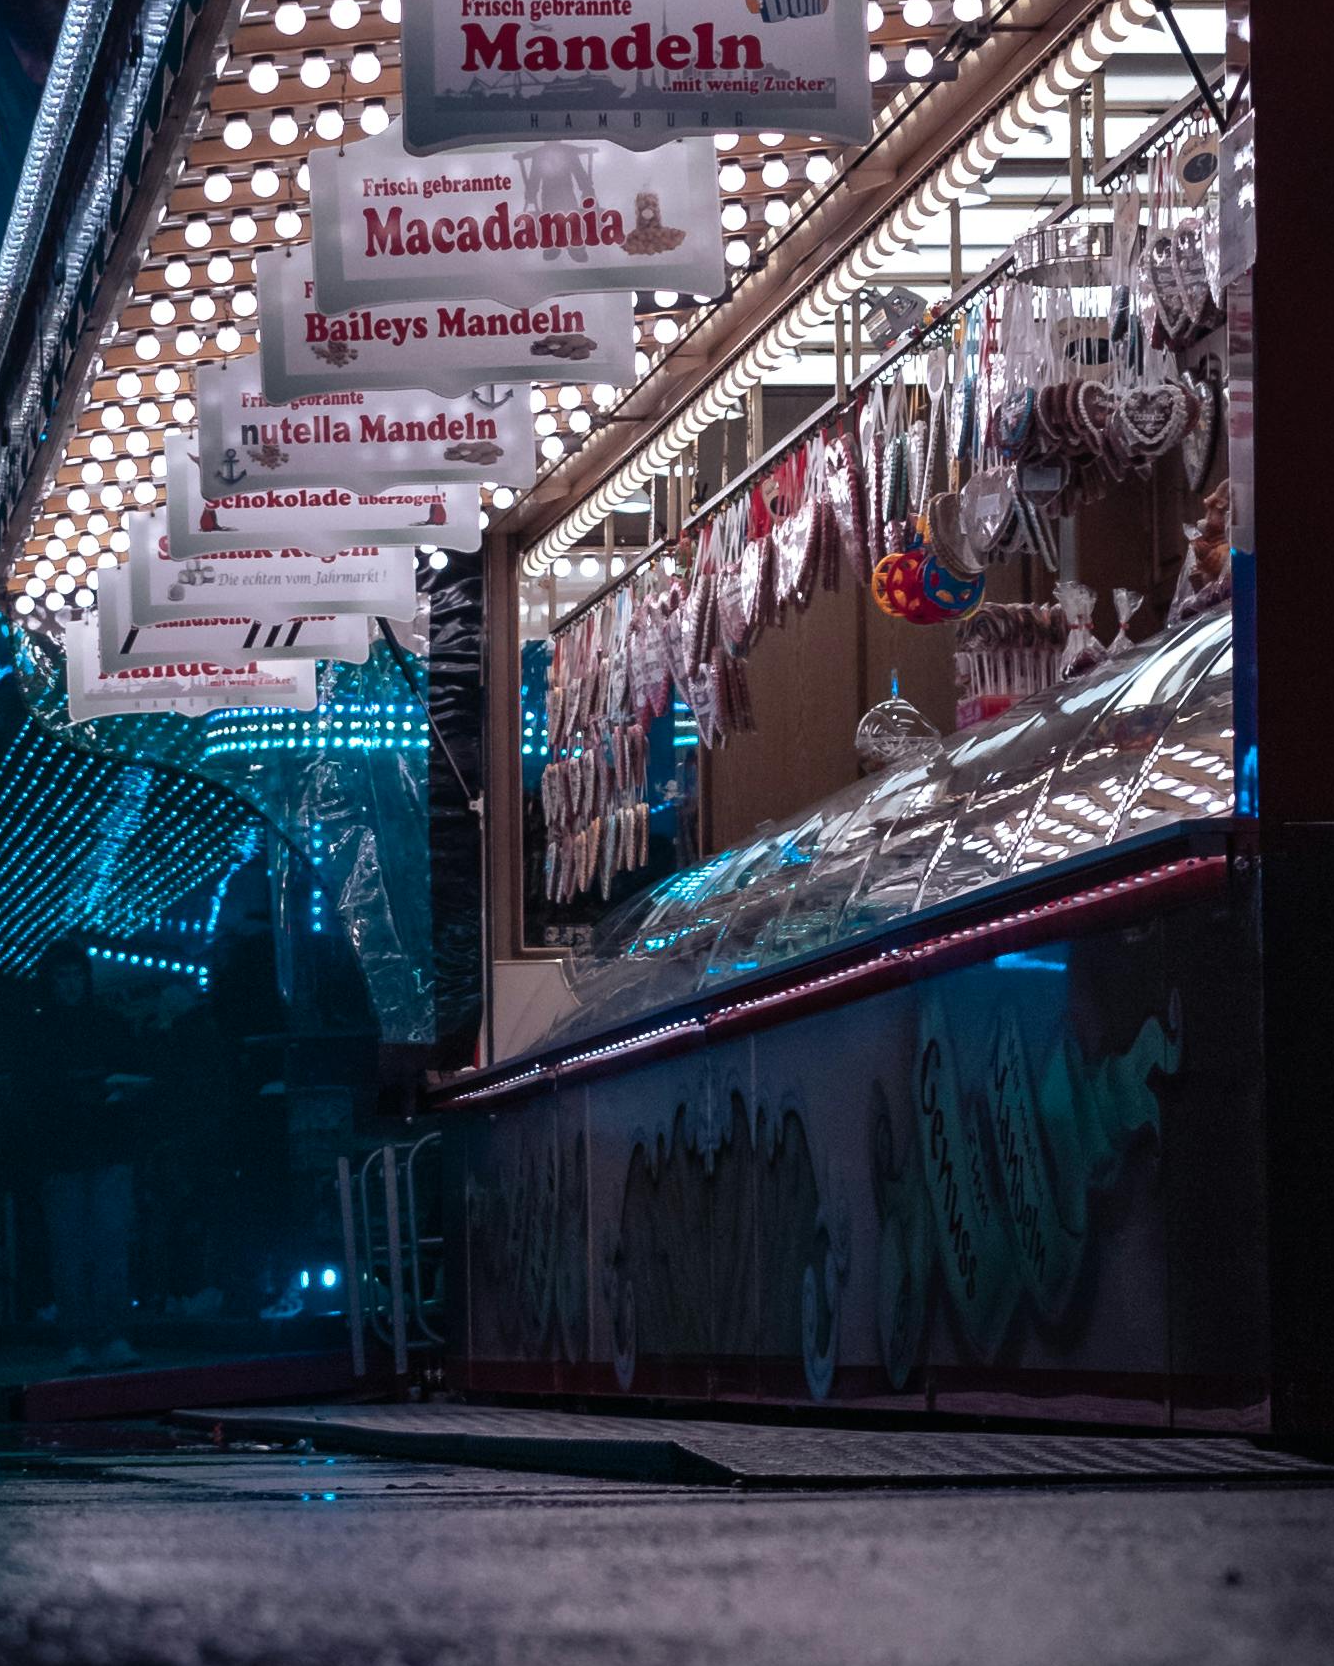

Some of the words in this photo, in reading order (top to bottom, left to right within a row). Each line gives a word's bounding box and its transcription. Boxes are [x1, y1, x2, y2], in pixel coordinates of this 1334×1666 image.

[460, 21, 765, 73] Mandeln
[705, 76, 760, 95] wenig
[763, 76, 827, 93] Zucker
[530, 110, 745, 130] HAMBURG
[362, 176, 418, 197] Frisch
[422, 173, 512, 199] gebrannte
[362, 197, 627, 258] Macadamia
[304, 310, 429, 345] Baileys
[436, 304, 586, 338] Mandeln
[241, 414, 352, 446] nutella
[359, 412, 497, 444] Mandeln
[217, 572, 240, 587] Die
[242, 572, 283, 586] echten
[285, 574, 312, 586] vom
[313, 569, 379, 587] Jahrmarkt
